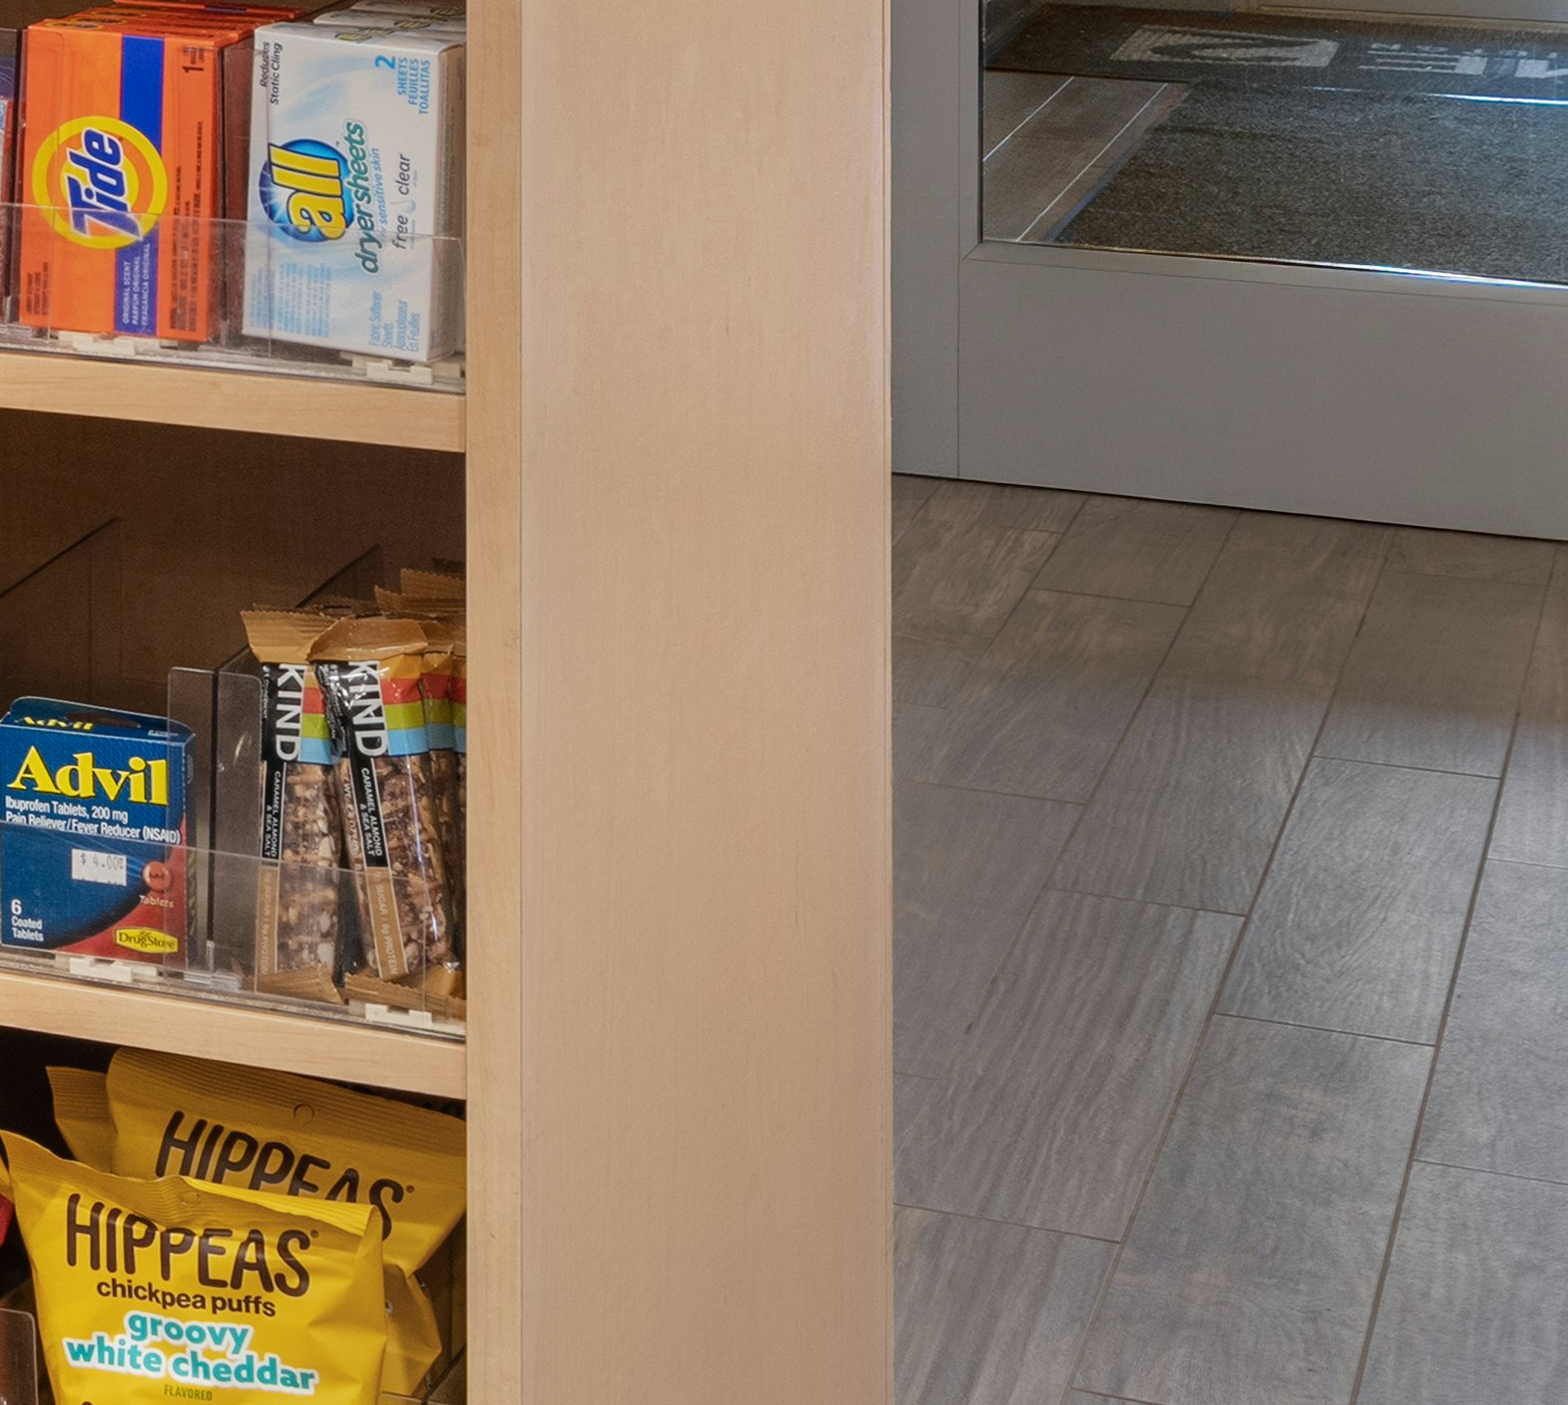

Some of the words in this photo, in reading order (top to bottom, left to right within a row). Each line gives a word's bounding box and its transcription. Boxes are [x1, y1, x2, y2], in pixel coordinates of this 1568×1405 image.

[259, 42, 270, 89] Reduces
[397, 57, 408, 96] SHEETS
[408, 58, 419, 106] FEUILLES
[419, 59, 431, 116] TOALLITAS
[66, 127, 144, 241] Tide
[268, 142, 347, 241] all
[395, 153, 411, 196] clear
[392, 215, 409, 250] free
[275, 662, 308, 761] KIND
[348, 661, 388, 756] KIND
[7, 745, 169, 805] Advil
[5, 795, 50, 813] Ibuprofen
[52, 801, 90, 819] Tablets,
[91, 807, 111, 819] 200
[113, 811, 128, 824] mg
[6, 813, 26, 825] Pain
[101, 823, 141, 838] Reducer
[143, 828, 181, 845] (NSAID)
[12, 917, 42, 930] Coated
[12, 927, 44, 941] Tablets
[66, 1192, 312, 1298] HIPPEAS
[96, 1277, 207, 1311] chickpea
[211, 1295, 277, 1319] puffs
[126, 1312, 251, 1357] groovy
[65, 1338, 166, 1374] white
[172, 1352, 316, 1392] cheddar
[163, 1384, 214, 1403] FLAVORED
